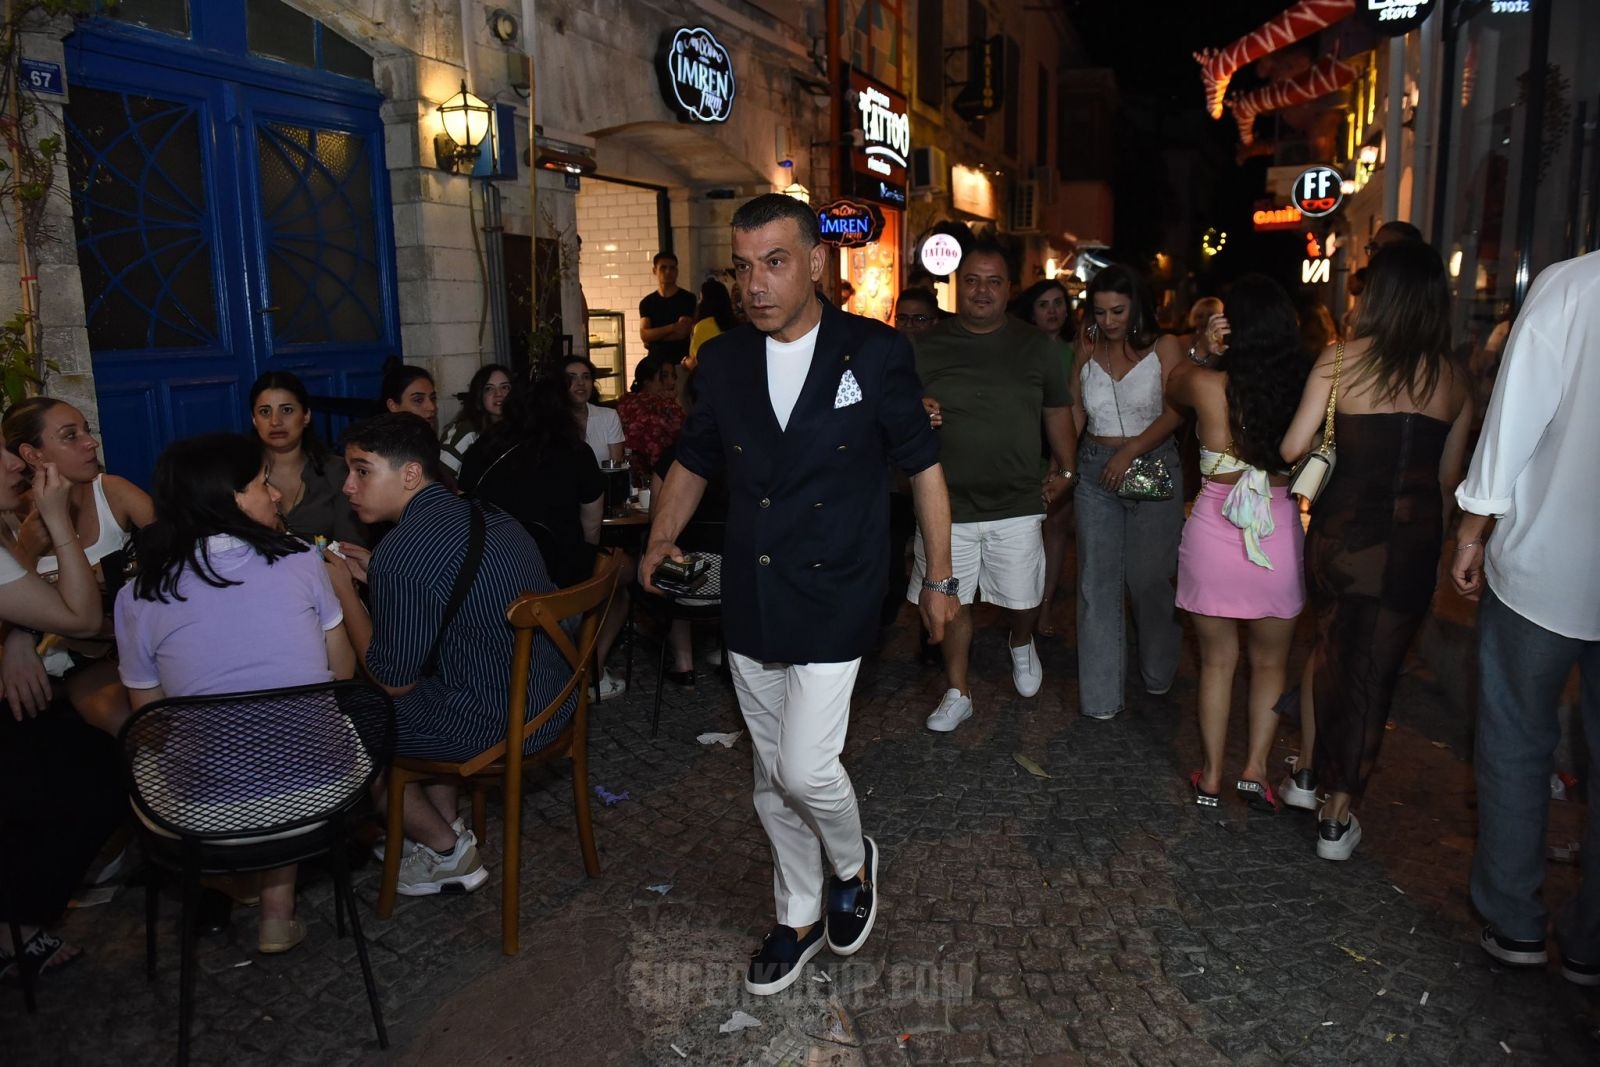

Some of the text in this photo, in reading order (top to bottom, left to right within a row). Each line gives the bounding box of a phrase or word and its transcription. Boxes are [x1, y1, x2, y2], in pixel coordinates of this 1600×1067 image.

[1379, 6, 1416, 20] store
[30, 70, 52, 88] 67
[859, 91, 910, 158] TATTOO
[1303, 171, 1331, 199] FF
[925, 248, 958, 258] TATTOO
